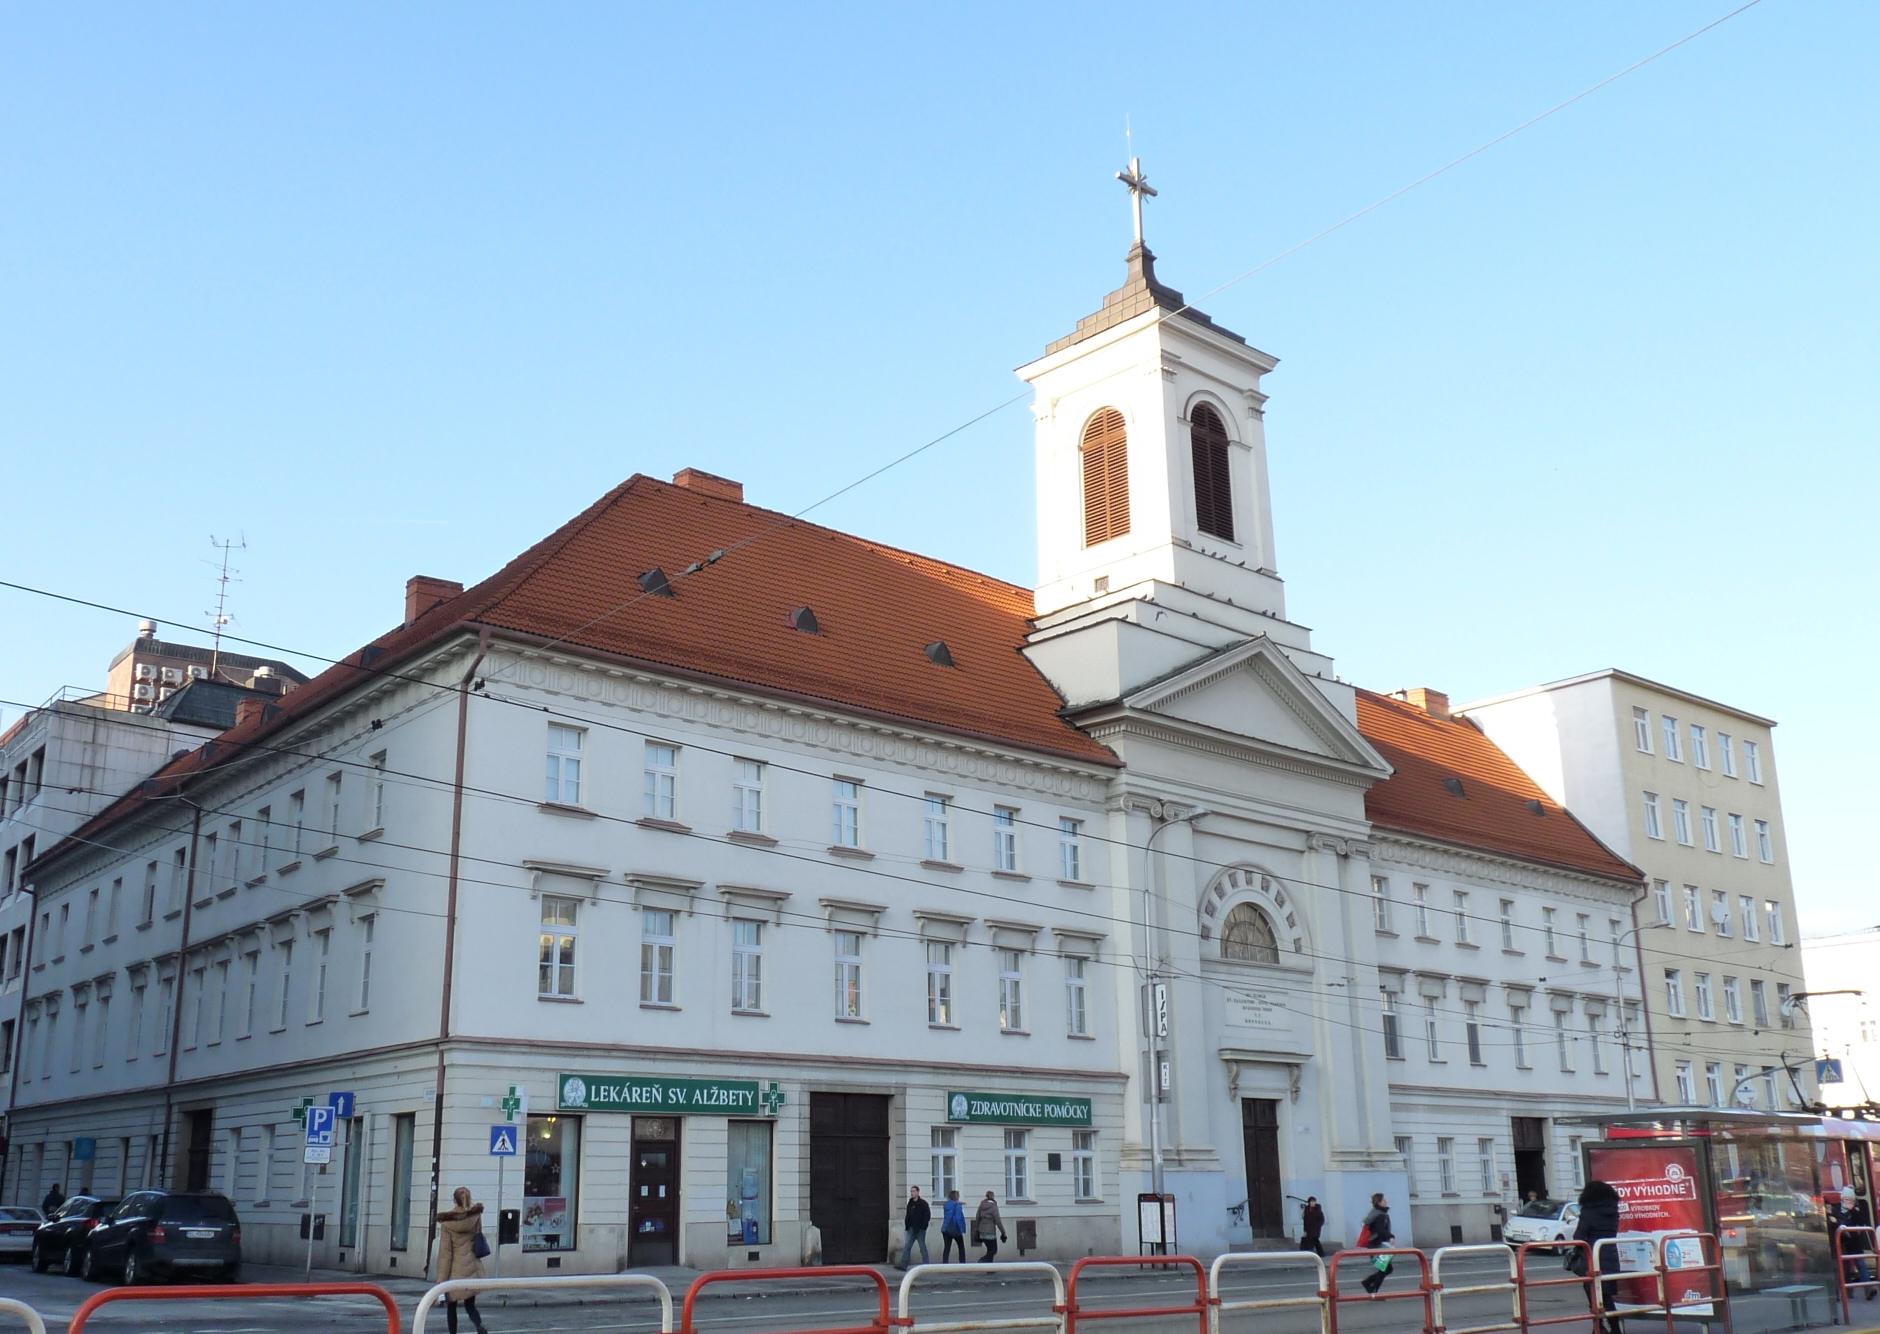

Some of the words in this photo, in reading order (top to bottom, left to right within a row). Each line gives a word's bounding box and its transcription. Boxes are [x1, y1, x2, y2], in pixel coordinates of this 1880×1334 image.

[591, 1083, 662, 1103] LEKÁREŇ
[668, 1088, 687, 1105] SV.
[692, 1087, 754, 1105] ALŽBETY
[970, 1099, 1042, 1117] ZDRAVOTNÍCKE
[1044, 1101, 1089, 1119] POMÔCKY
[314, 1109, 327, 1131] P
[1633, 1183, 1687, 1197] VÝHODNE
